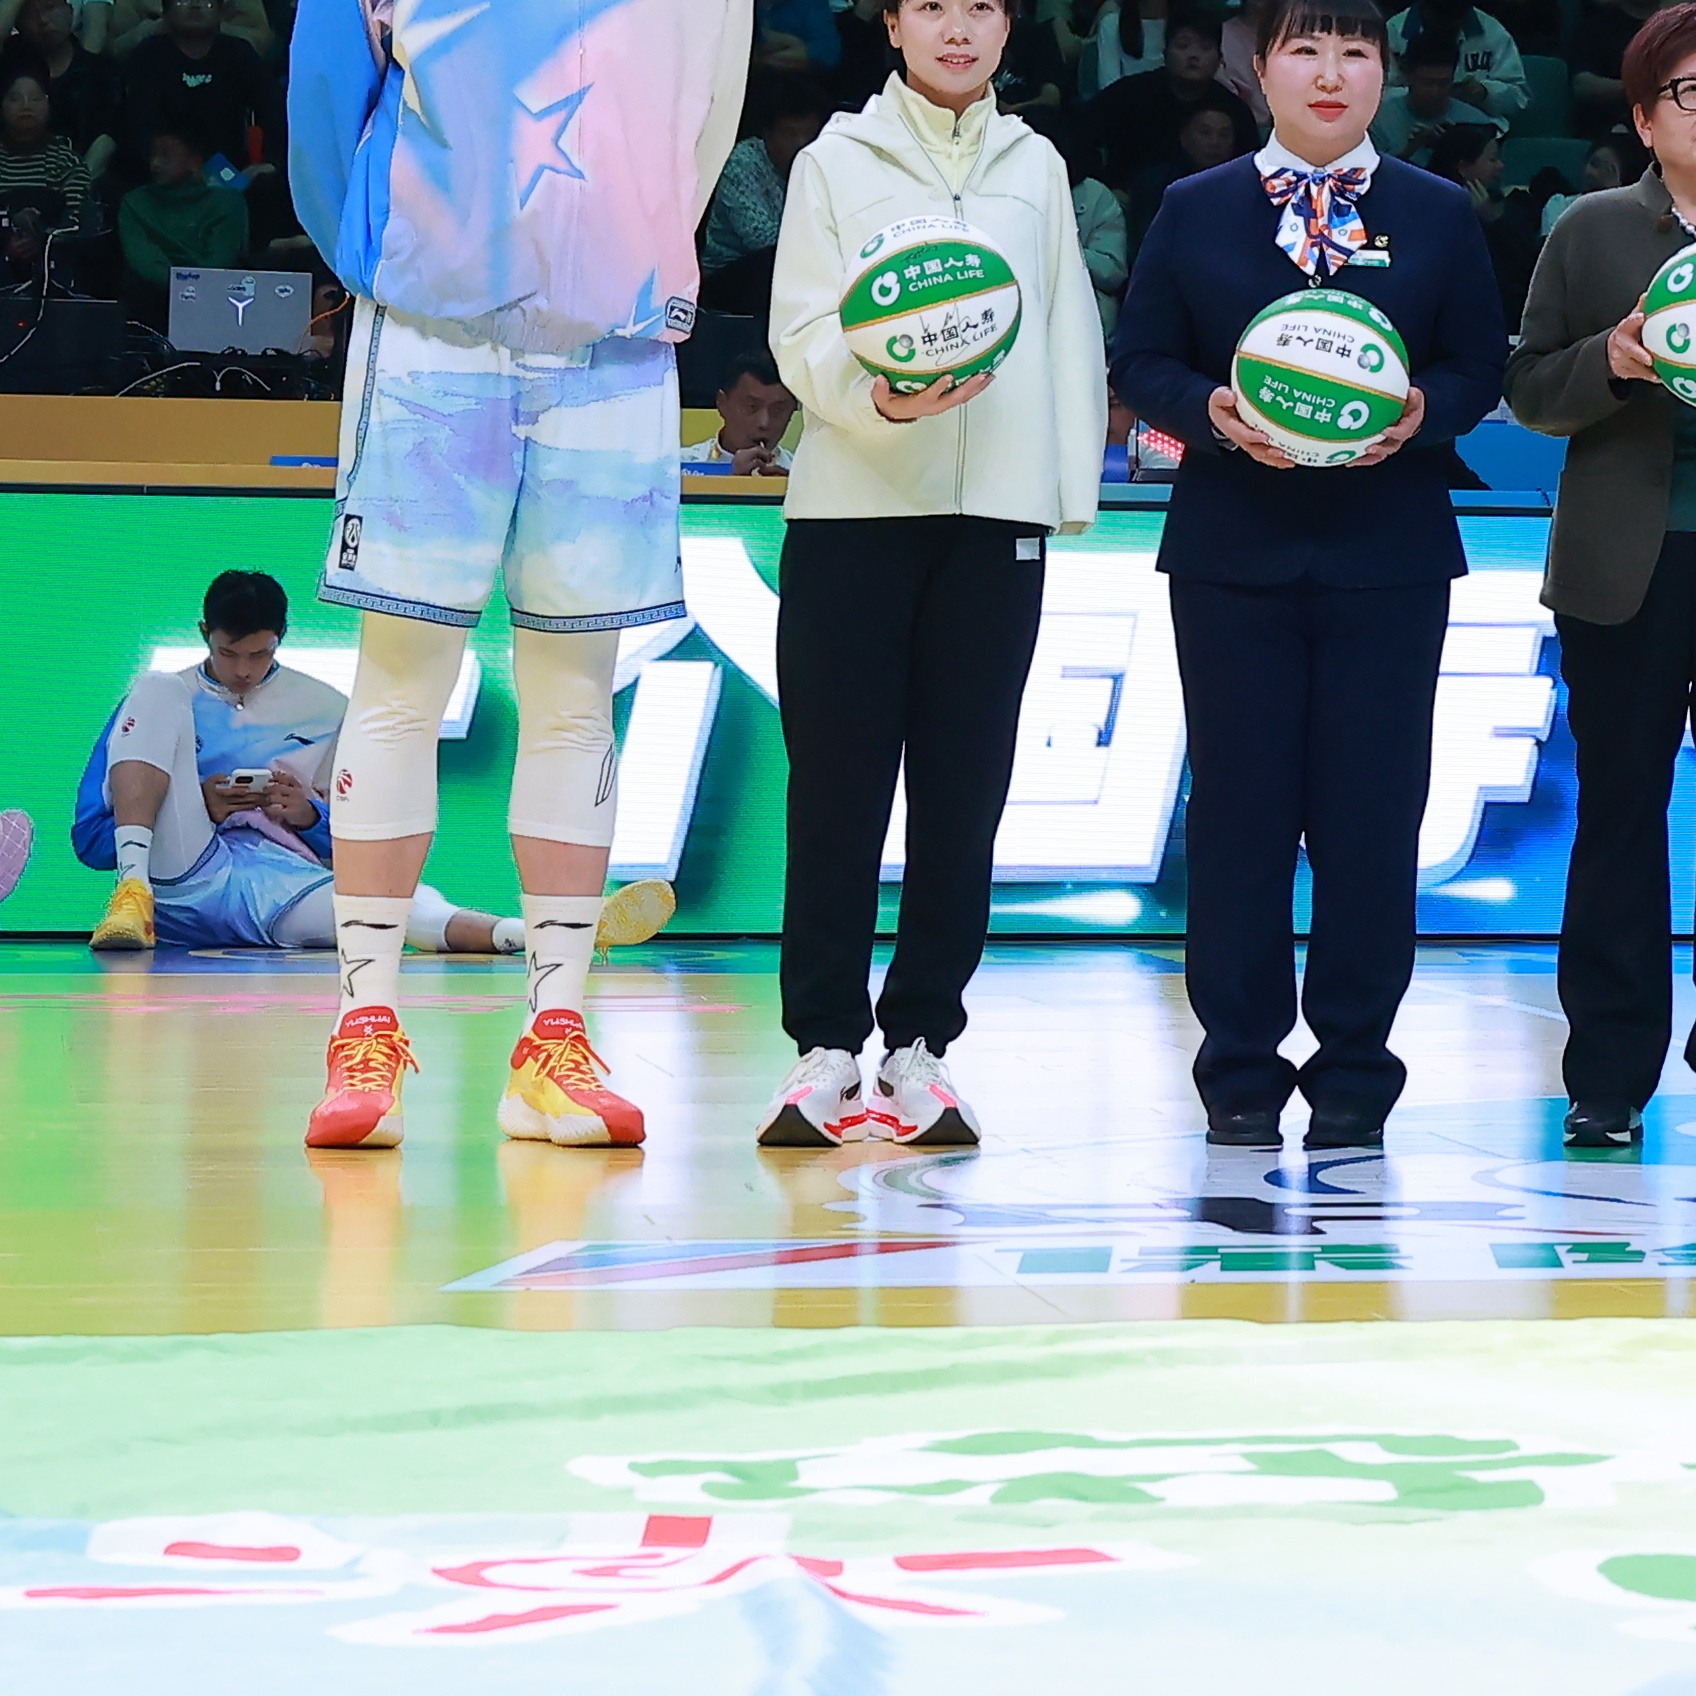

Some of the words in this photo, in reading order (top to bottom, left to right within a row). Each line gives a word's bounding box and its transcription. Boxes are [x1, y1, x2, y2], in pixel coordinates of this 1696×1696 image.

[903, 253, 982, 281] 中国人寿
[908, 273, 954, 293] CHINA
[956, 269, 986, 281] LIFE
[921, 307, 996, 348] 中国人寿
[925, 338, 971, 358] CHINA
[972, 323, 999, 342] LIFE
[1280, 323, 1309, 333] LIFE
[1313, 327, 1356, 344] CHINA
[1276, 332, 1353, 360] 中国人寿
[1262, 374, 1291, 395] LIFE
[1258, 385, 1334, 425] 中国人寿
[1293, 388, 1337, 409] CHINA
